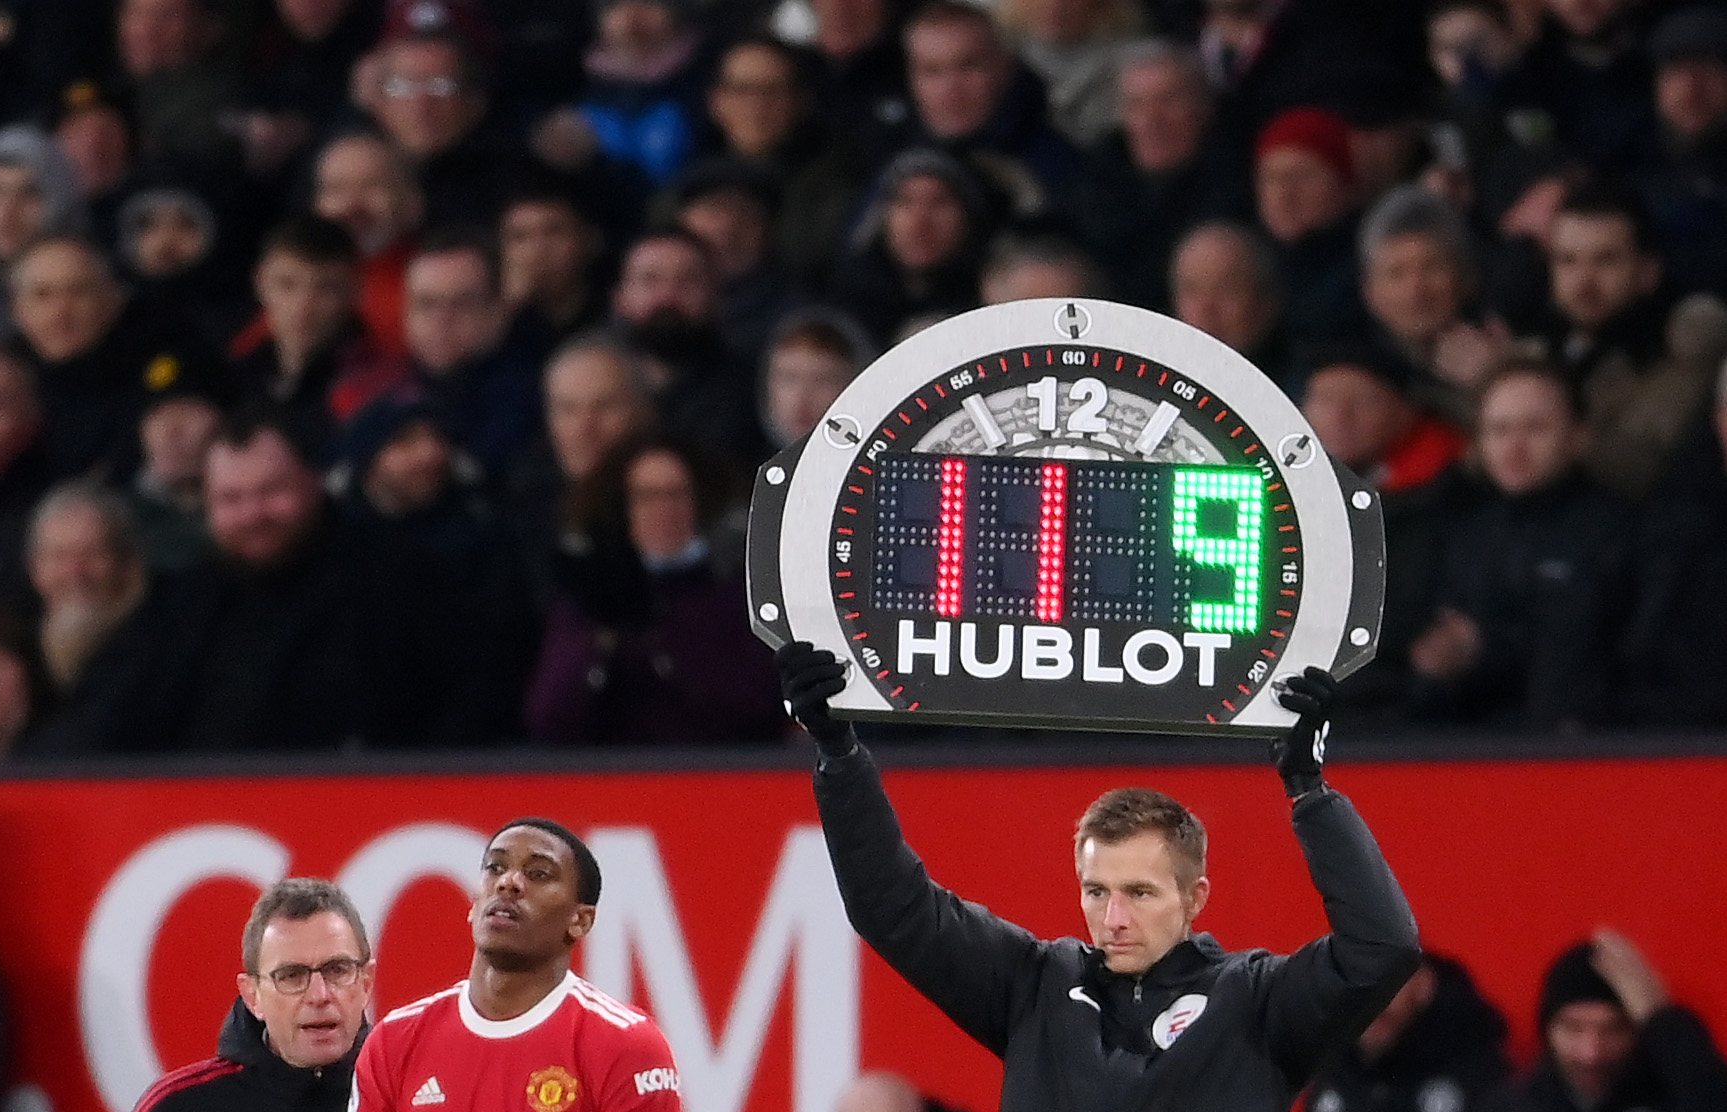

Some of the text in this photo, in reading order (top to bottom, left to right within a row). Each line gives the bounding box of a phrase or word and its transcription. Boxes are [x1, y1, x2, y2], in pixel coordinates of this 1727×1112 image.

[1062, 350, 1086, 366] 60
[949, 369, 974, 391] 55
[1172, 379, 1198, 401] 05
[1026, 376, 1109, 433] 12
[835, 540, 852, 563] 45
[935, 458, 1264, 635] 11 9
[1281, 561, 1298, 585] 15
[861, 646, 882, 669] 40
[896, 618, 1233, 687] HUBLOT
[1247, 659, 1269, 684] 20
